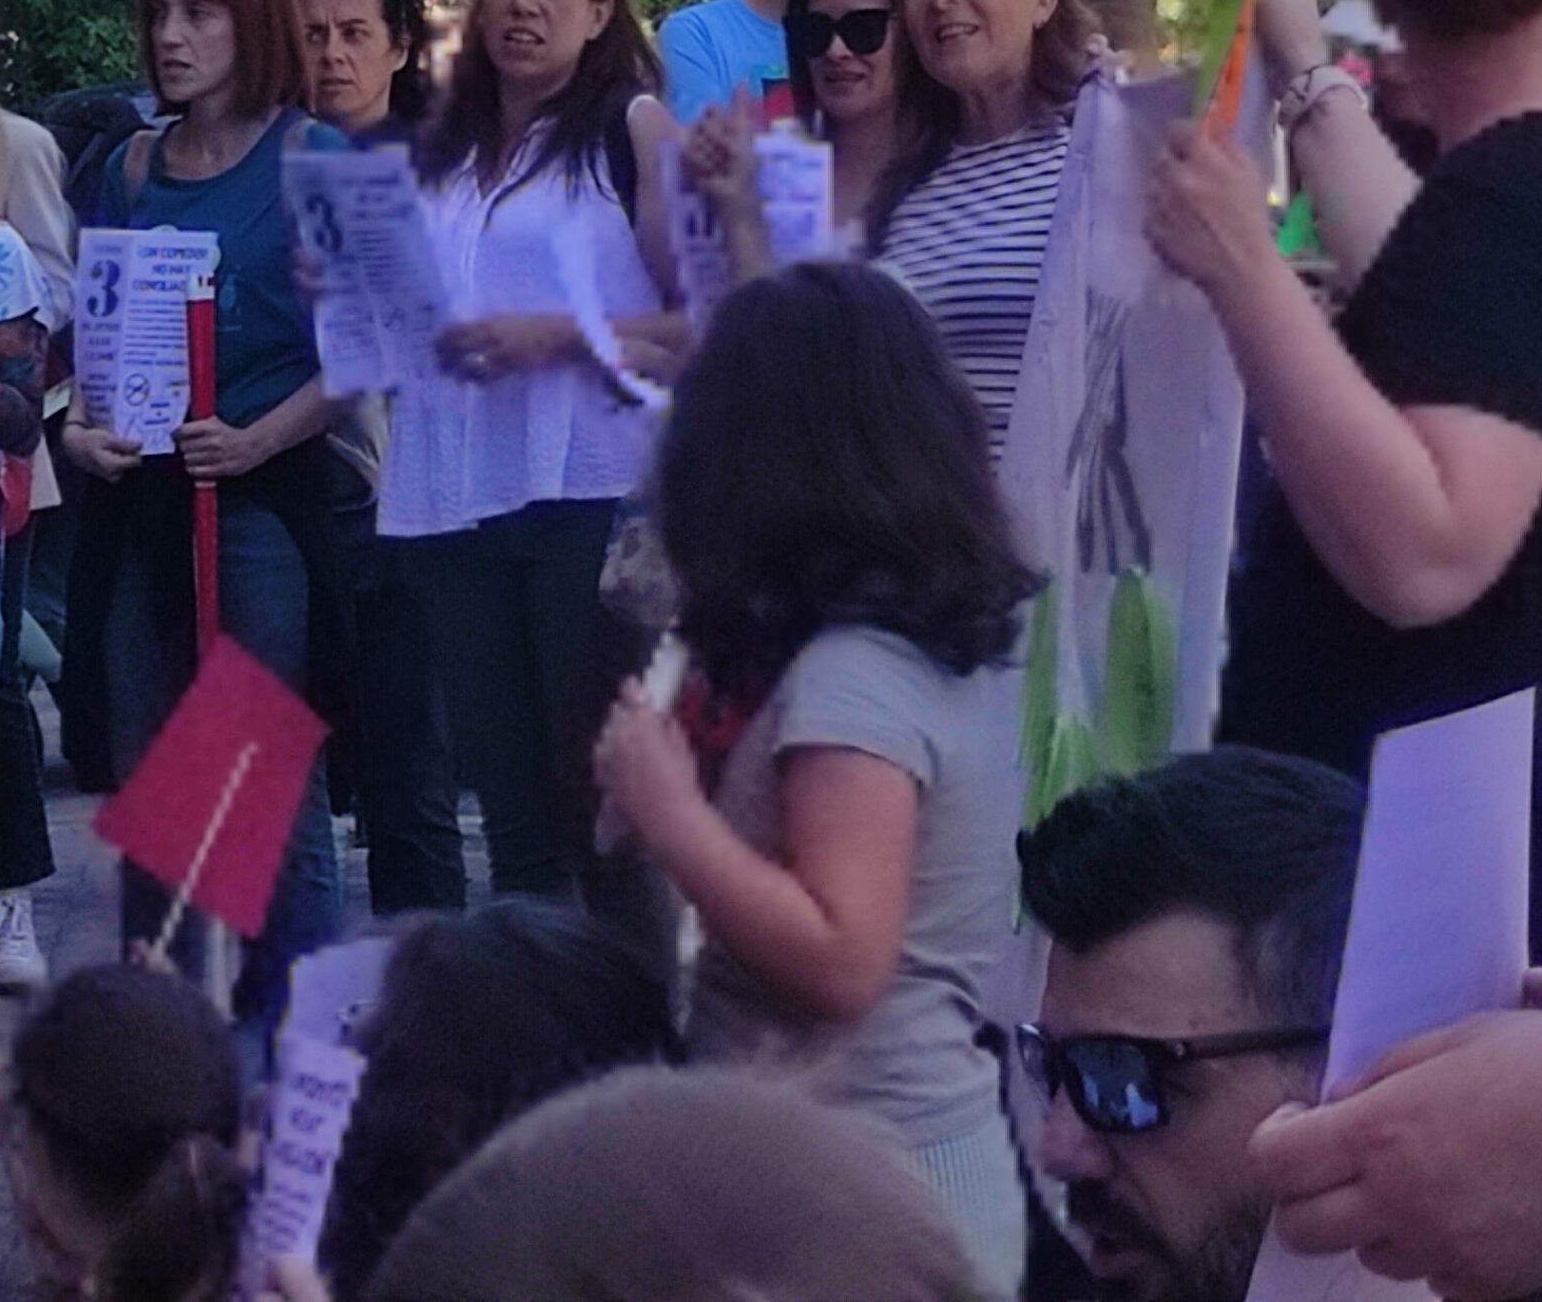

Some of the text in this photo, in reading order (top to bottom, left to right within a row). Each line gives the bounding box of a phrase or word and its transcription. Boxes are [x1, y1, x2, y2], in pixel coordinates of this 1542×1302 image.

[307, 195, 343, 252] 3
[87, 259, 121, 317] 3
[153, 264, 167, 275] NO
